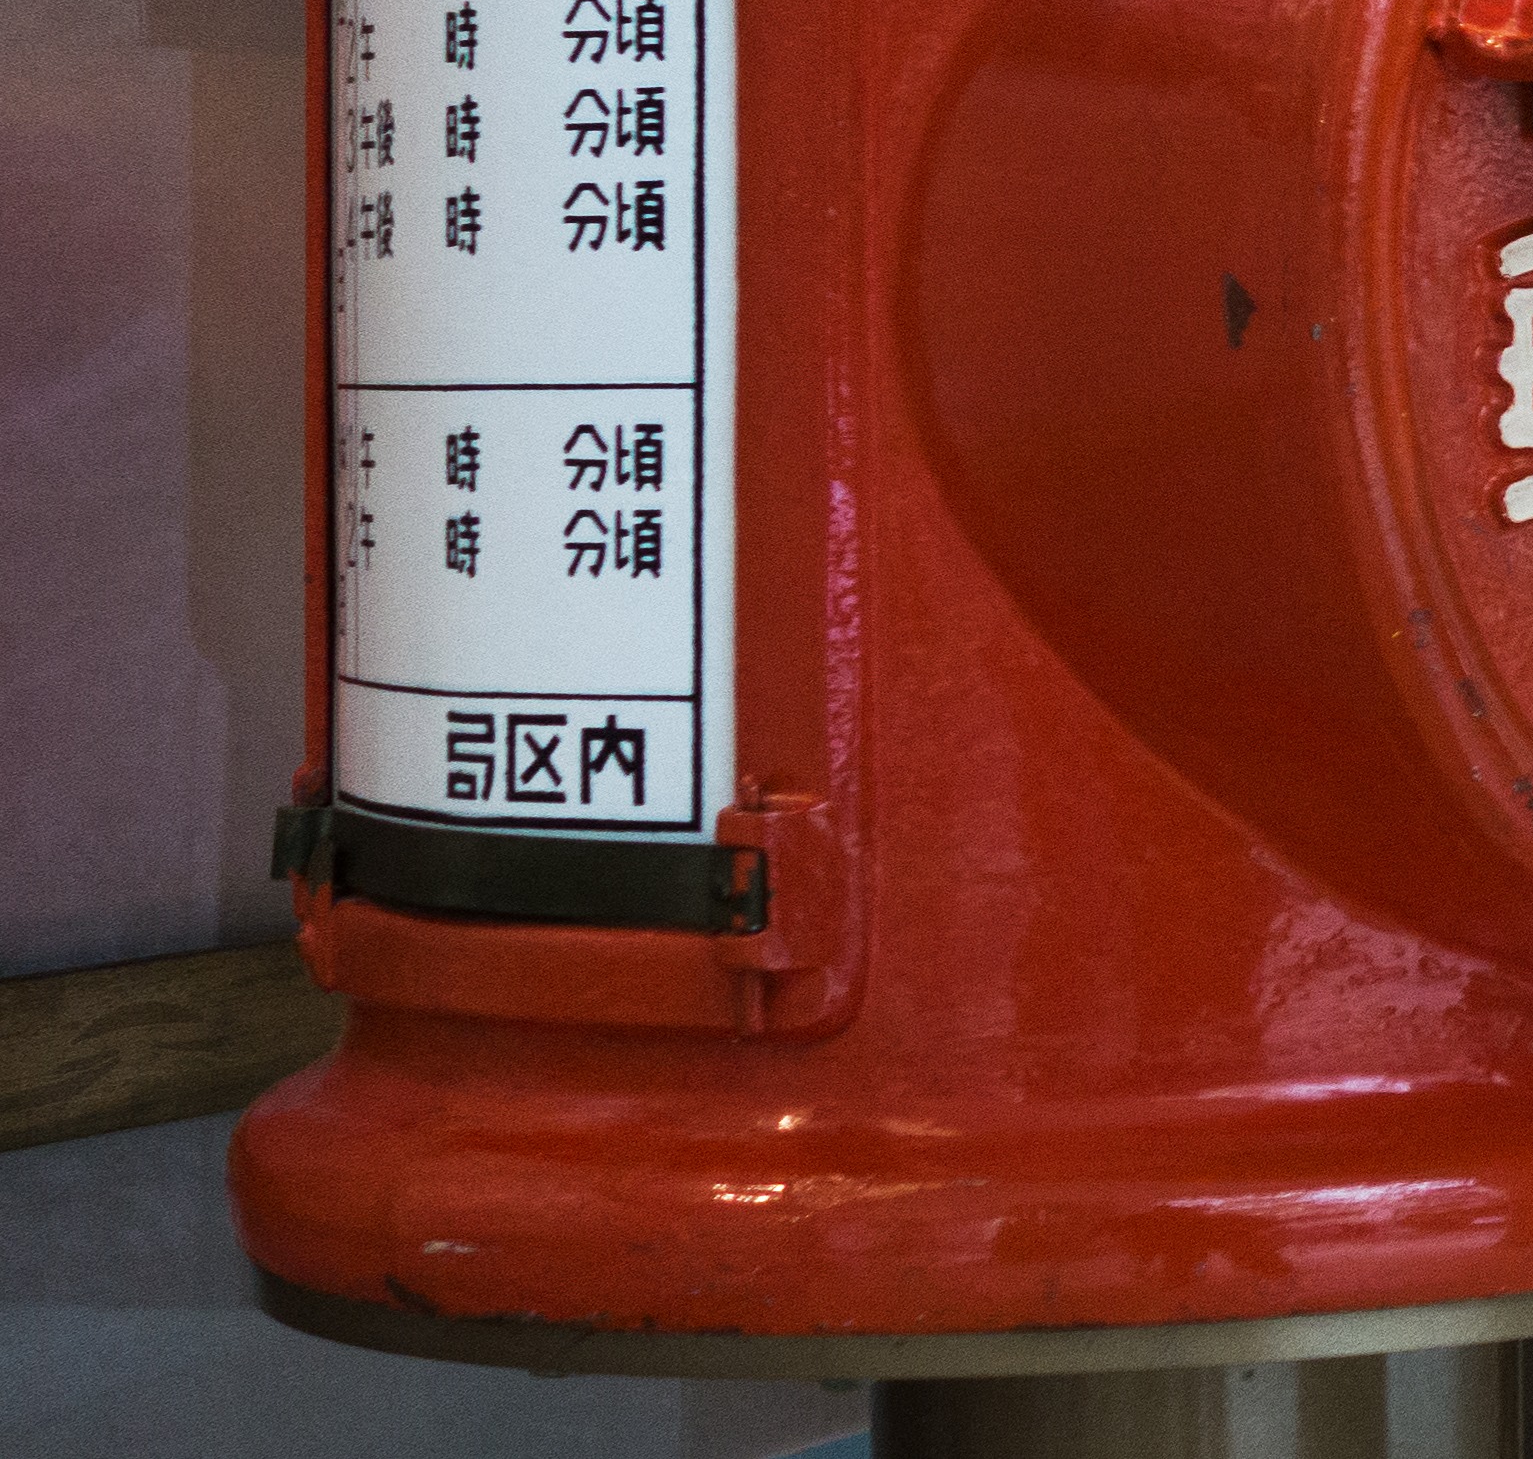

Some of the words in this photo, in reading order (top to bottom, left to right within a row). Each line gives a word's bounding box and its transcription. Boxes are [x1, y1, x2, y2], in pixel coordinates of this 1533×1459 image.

[444, 0, 479, 70] 時
[444, 93, 479, 164] 時
[444, 185, 482, 256] 時
[445, 425, 481, 493] 時
[445, 509, 481, 579] 時
